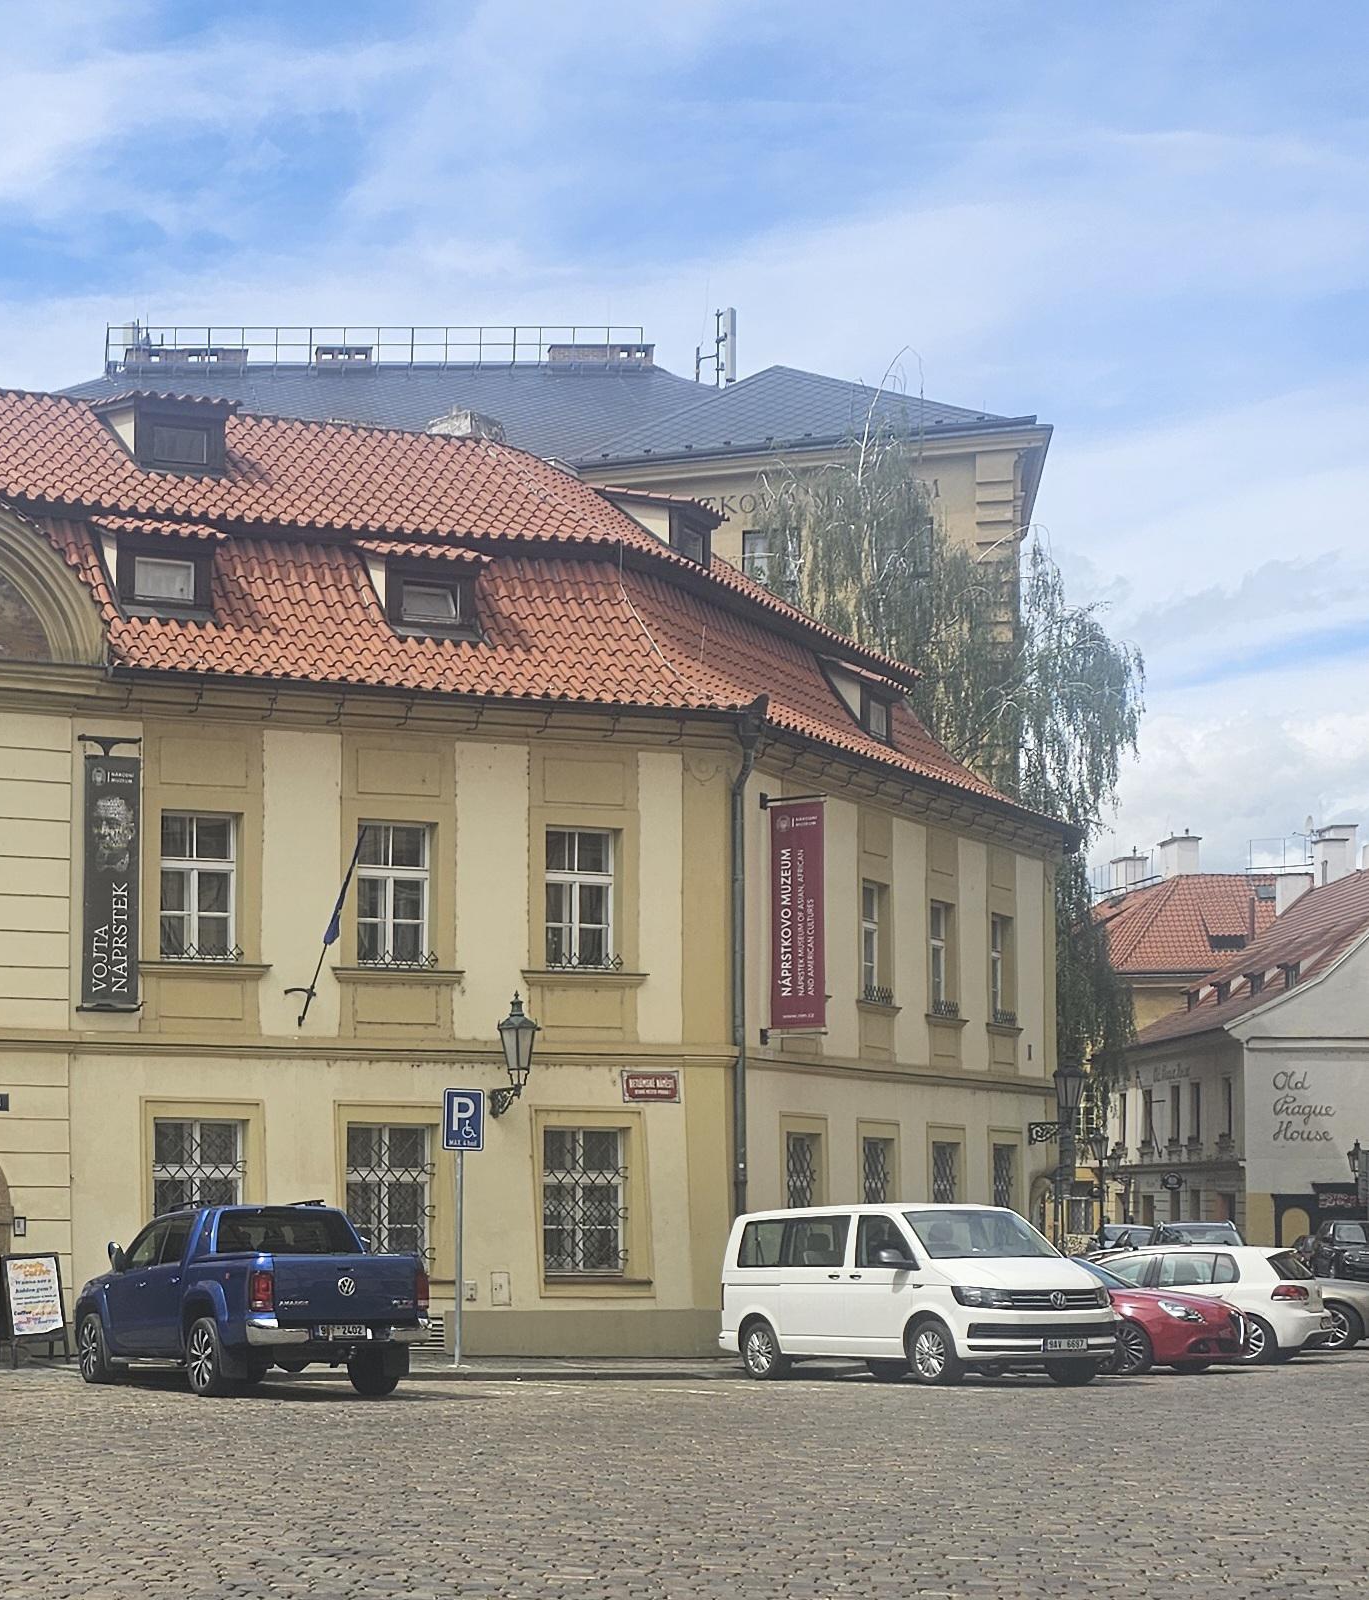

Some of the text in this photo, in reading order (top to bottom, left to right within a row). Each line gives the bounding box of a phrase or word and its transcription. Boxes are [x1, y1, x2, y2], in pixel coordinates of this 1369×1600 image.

[107, 882, 128, 993] NÁPRSTEK
[778, 848, 792, 997] NÁPRSTKOVO MUZEUM
[797, 849, 805, 996] NÁPRSTEK MUSEUM OF ASIAN, AFRICAN
[806, 898, 815, 996] AND AMERICAN CULTURES
[92, 924, 109, 992] VOJTA
[1272, 1070, 1311, 1091] Old
[452, 1096, 475, 1131] P
[1272, 1094, 1337, 1125] Prague
[1272, 1120, 1333, 1142] House
[341, 1325, 363, 1335] 2402
